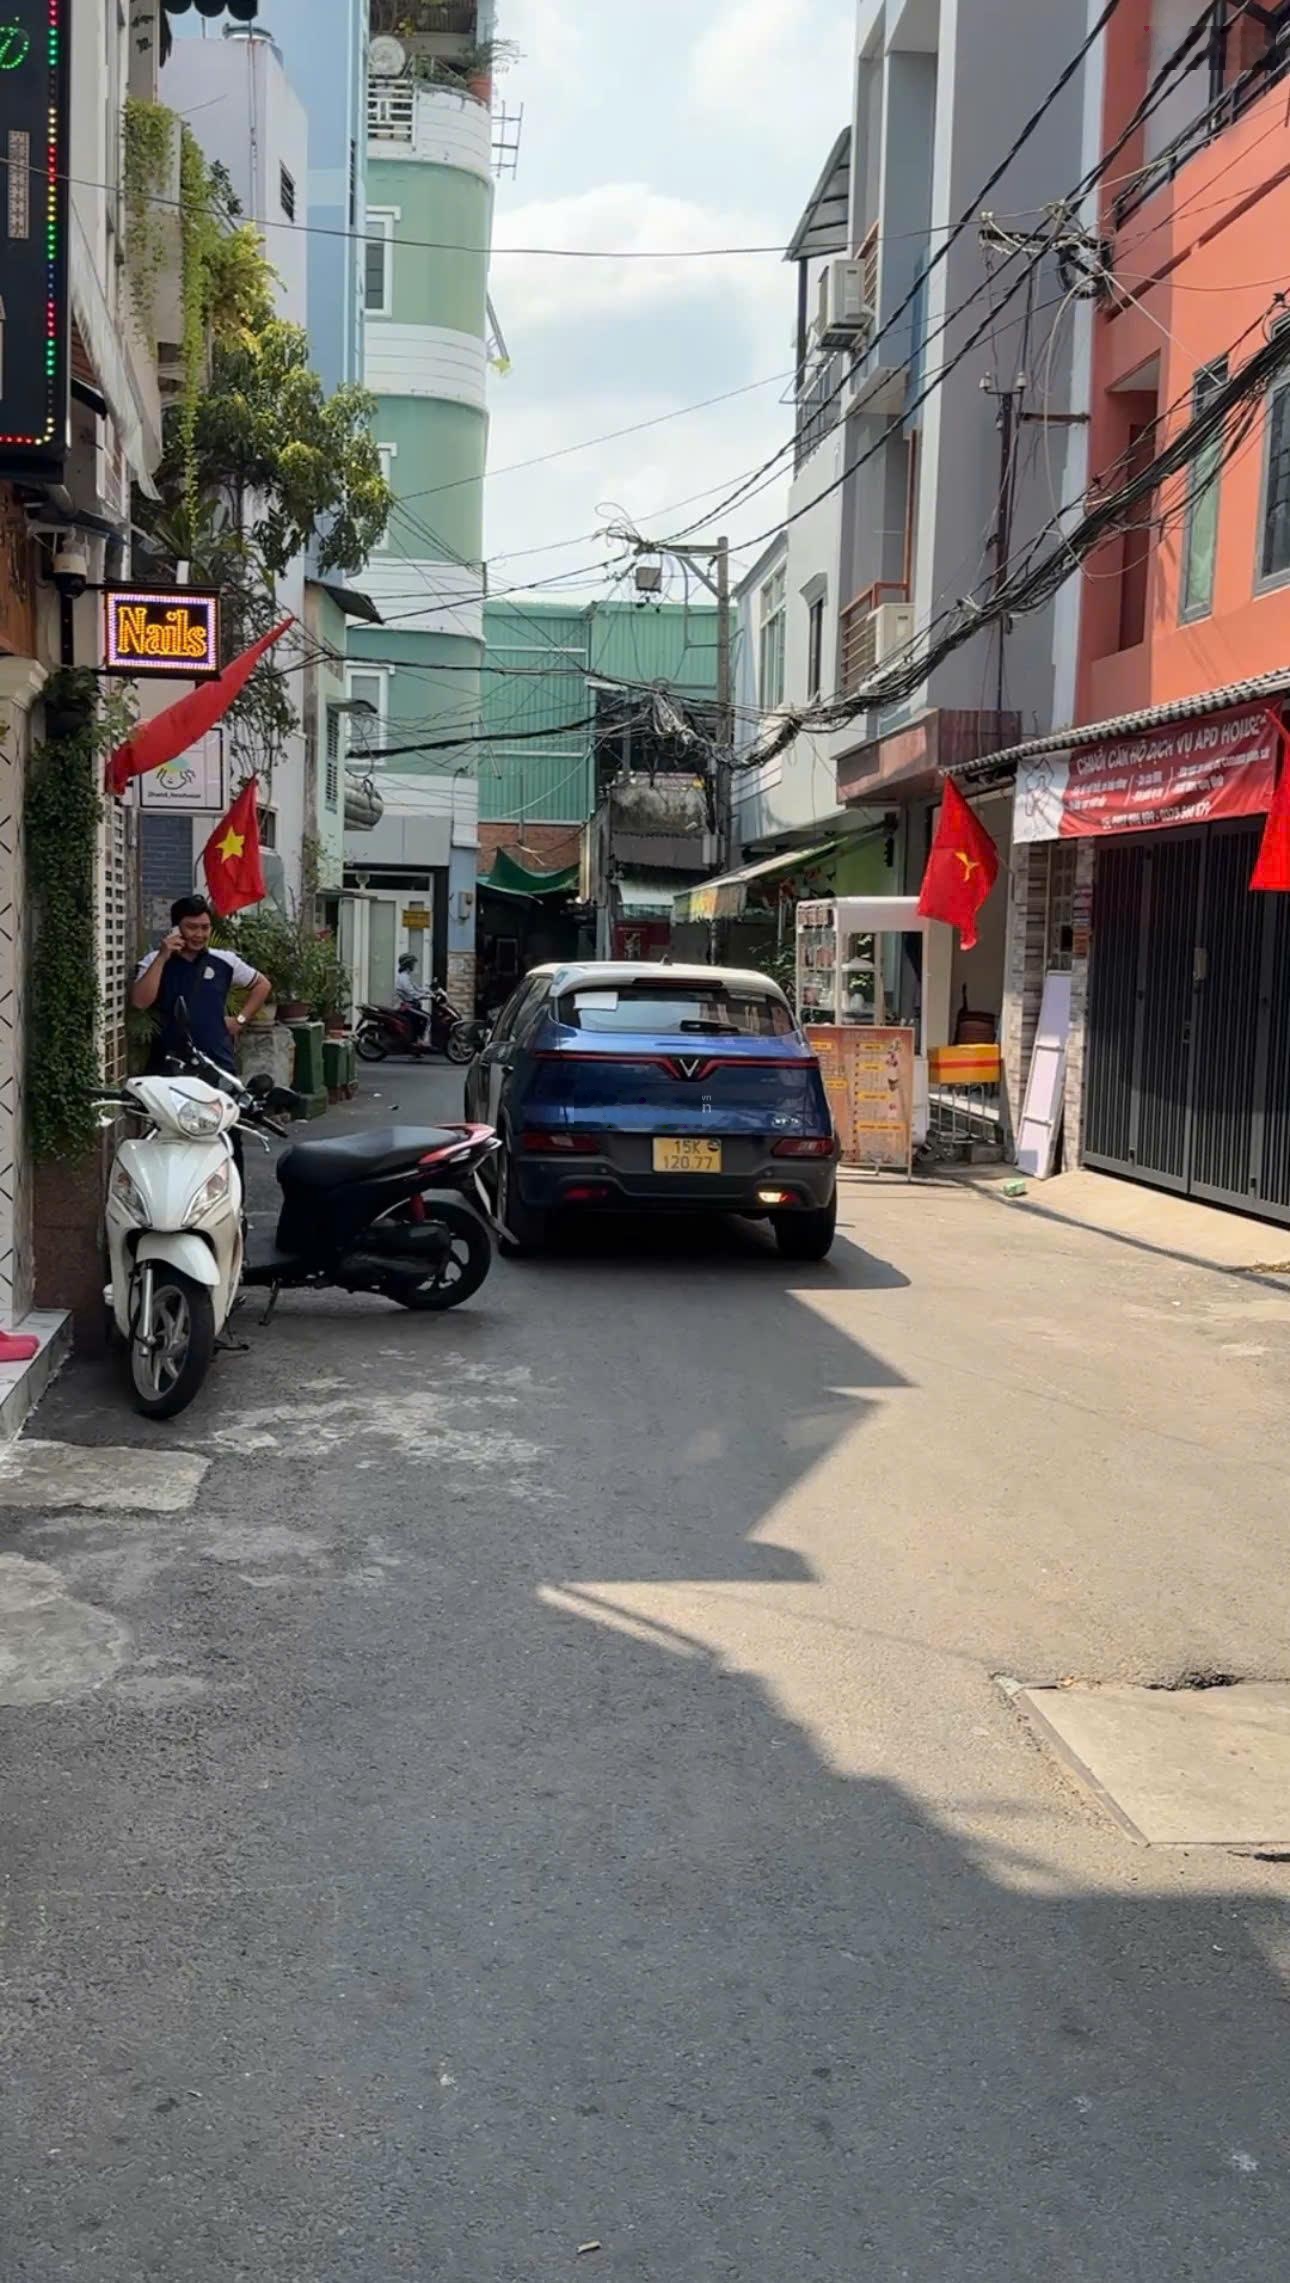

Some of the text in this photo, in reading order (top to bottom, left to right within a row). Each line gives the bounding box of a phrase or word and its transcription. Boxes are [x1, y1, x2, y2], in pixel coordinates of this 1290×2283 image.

[117, 606, 207, 657] Nails
[674, 1140, 700, 1154] 15K
[664, 1155, 713, 1169] 120.77
